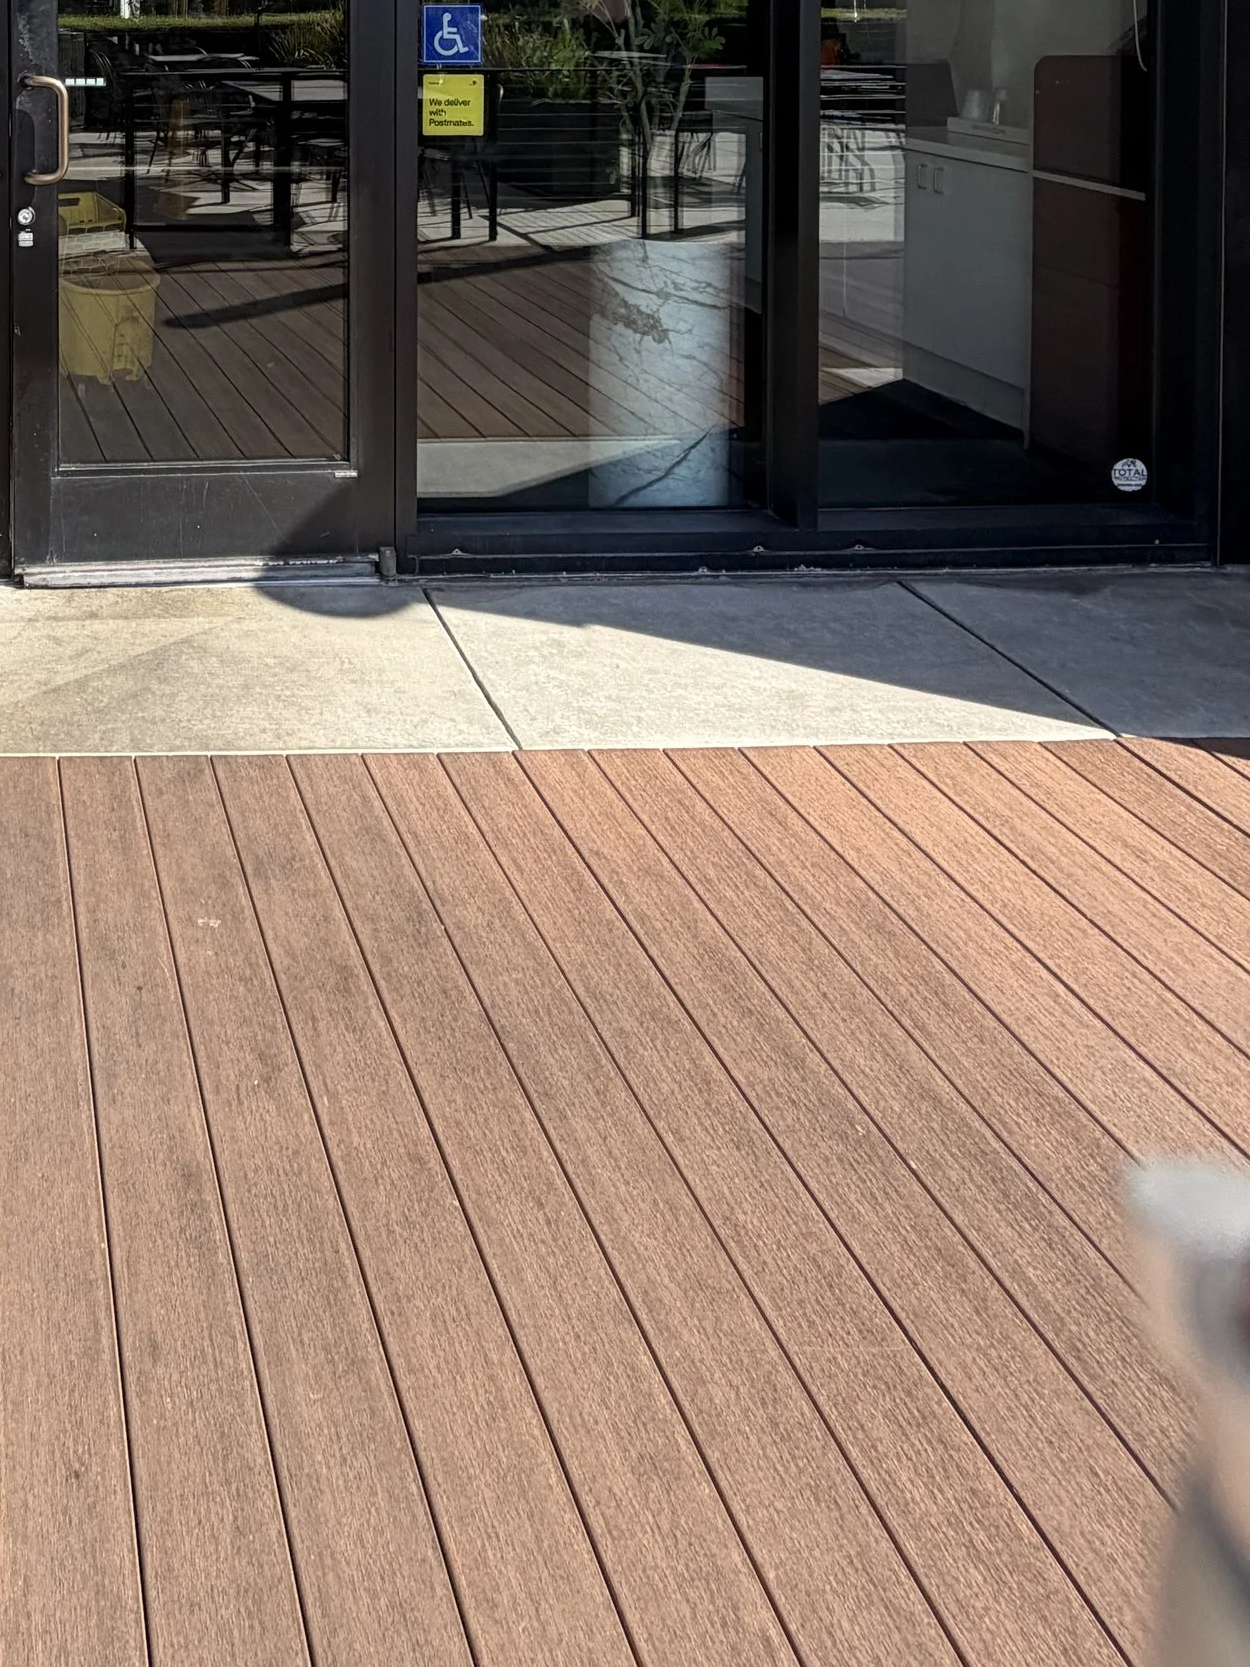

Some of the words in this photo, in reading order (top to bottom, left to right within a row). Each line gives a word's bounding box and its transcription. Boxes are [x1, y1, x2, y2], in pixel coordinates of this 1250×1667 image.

[428, 98, 443, 107] We
[443, 98, 471, 107] deliver
[428, 108, 447, 117] with
[428, 118, 475, 127] Postmates.
[1113, 468, 1148, 477] TOTAL
